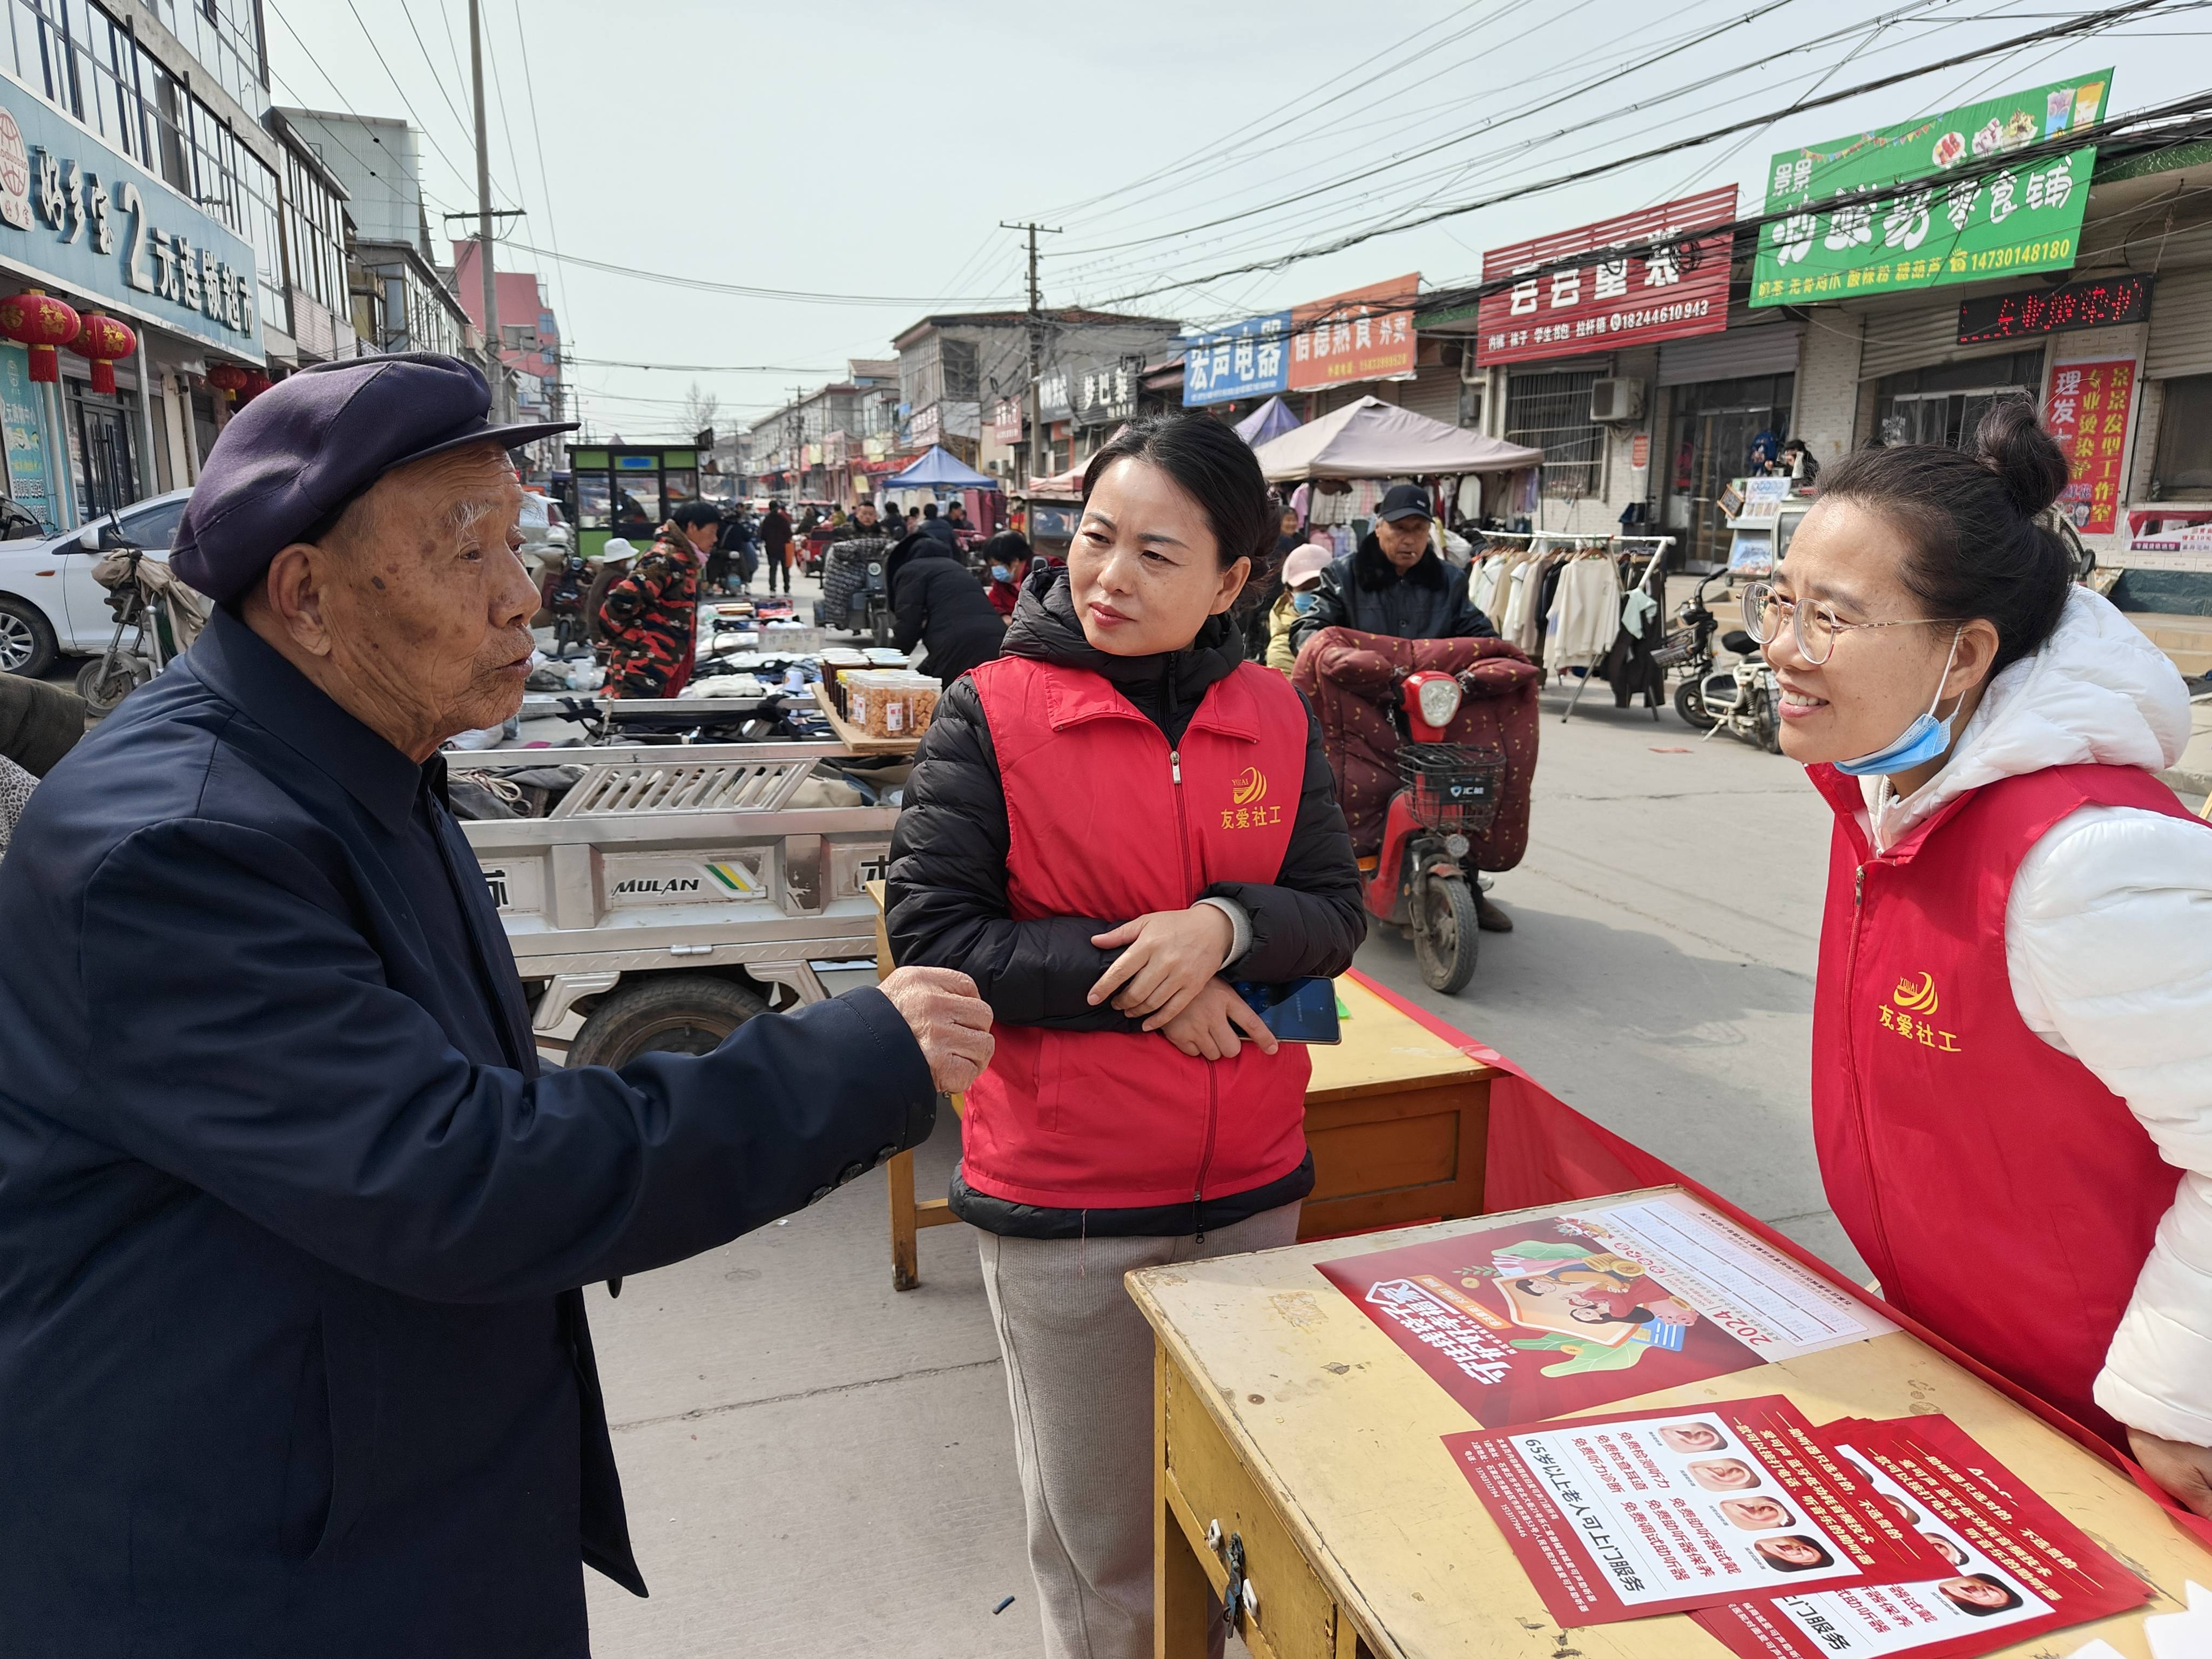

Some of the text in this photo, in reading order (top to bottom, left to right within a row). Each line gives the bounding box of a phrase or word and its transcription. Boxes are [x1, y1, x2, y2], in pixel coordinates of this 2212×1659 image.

[1772, 159, 1812, 195] 景景
[1758, 279, 1784, 296] 奶茶
[1847, 264, 1890, 288] 酸辣粉
[1895, 257, 1942, 281] 糖葫芦
[1972, 238, 2071, 271] 14730148180
[1190, 319, 1282, 391] 宏声电器
[1380, 316, 1406, 346] 外卖
[1510, 331, 1528, 347] 袜子
[1534, 323, 1570, 343] 学生书包
[1576, 316, 1607, 337] 拉杆箱
[1622, 300, 1709, 329] 18244610943
[2092, 367, 2129, 522] 景景发型工作室
[1221, 806, 1281, 830] 友爱社工
[612, 878, 699, 896] MULAN
[1900, 976, 1918, 994] YOUAI
[1878, 1004, 1961, 1052] 友爱社工
[1377, 1283, 1506, 1360] 护好幸福家
[1379, 1305, 1513, 1384] 守住钱袋子
[1710, 1310, 1773, 1346] 2024
[1500, 1504, 1528, 1537] 15131179646
[1523, 1438, 1648, 1593] 65岁以上老人可上门服务
[1570, 1437, 1692, 1581] 免费听力诊断 免费调试助听器
[1594, 1434, 1717, 1577] 免费检查耳道 免费助听器保养
[1616, 1432, 1742, 1574] 免费检测听力 免费助听器试戴
[1732, 1417, 1876, 1565] 一款可以接打电话、听音乐的助听器
[1758, 1429, 1878, 1544] 爱可声 蓝牙低功耗音频技术
[1897, 1458, 1940, 1487] 爱可声
[1933, 1487, 2054, 1577] 蓝牙低功耗音频技术
[1866, 1447, 2063, 1602] 一款可以接打电话、听音乐的助听器
[1885, 1582, 1939, 1624] 器试戴
